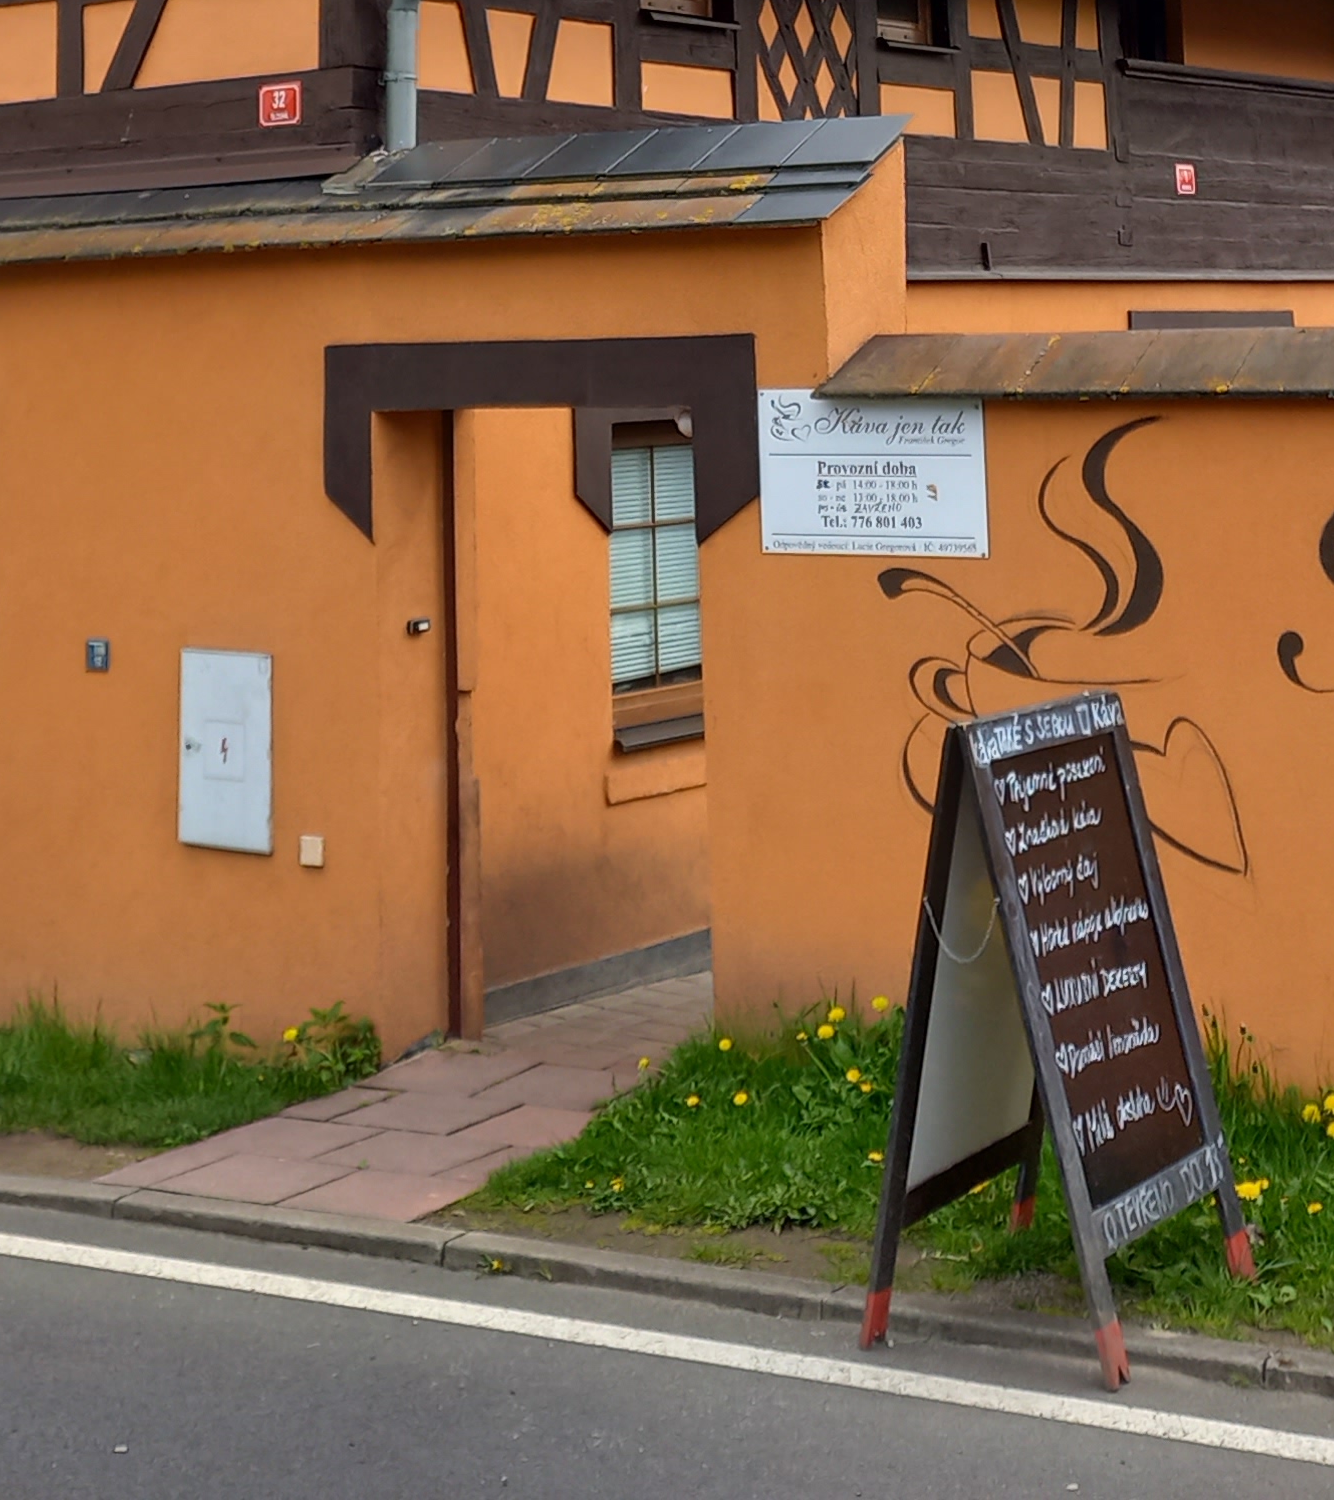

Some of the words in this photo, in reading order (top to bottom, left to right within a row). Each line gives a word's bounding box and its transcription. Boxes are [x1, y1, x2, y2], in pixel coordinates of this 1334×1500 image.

[271, 90, 286, 109] 32
[814, 406, 888, 434] Káva
[886, 415, 924, 445] jen
[931, 410, 966, 434] tak
[817, 460, 879, 476] Provozní
[882, 461, 917, 476] doba
[821, 515, 848, 528] Tel.:
[851, 516, 873, 529] 776
[875, 516, 896, 529] 801
[900, 516, 923, 529] 403
